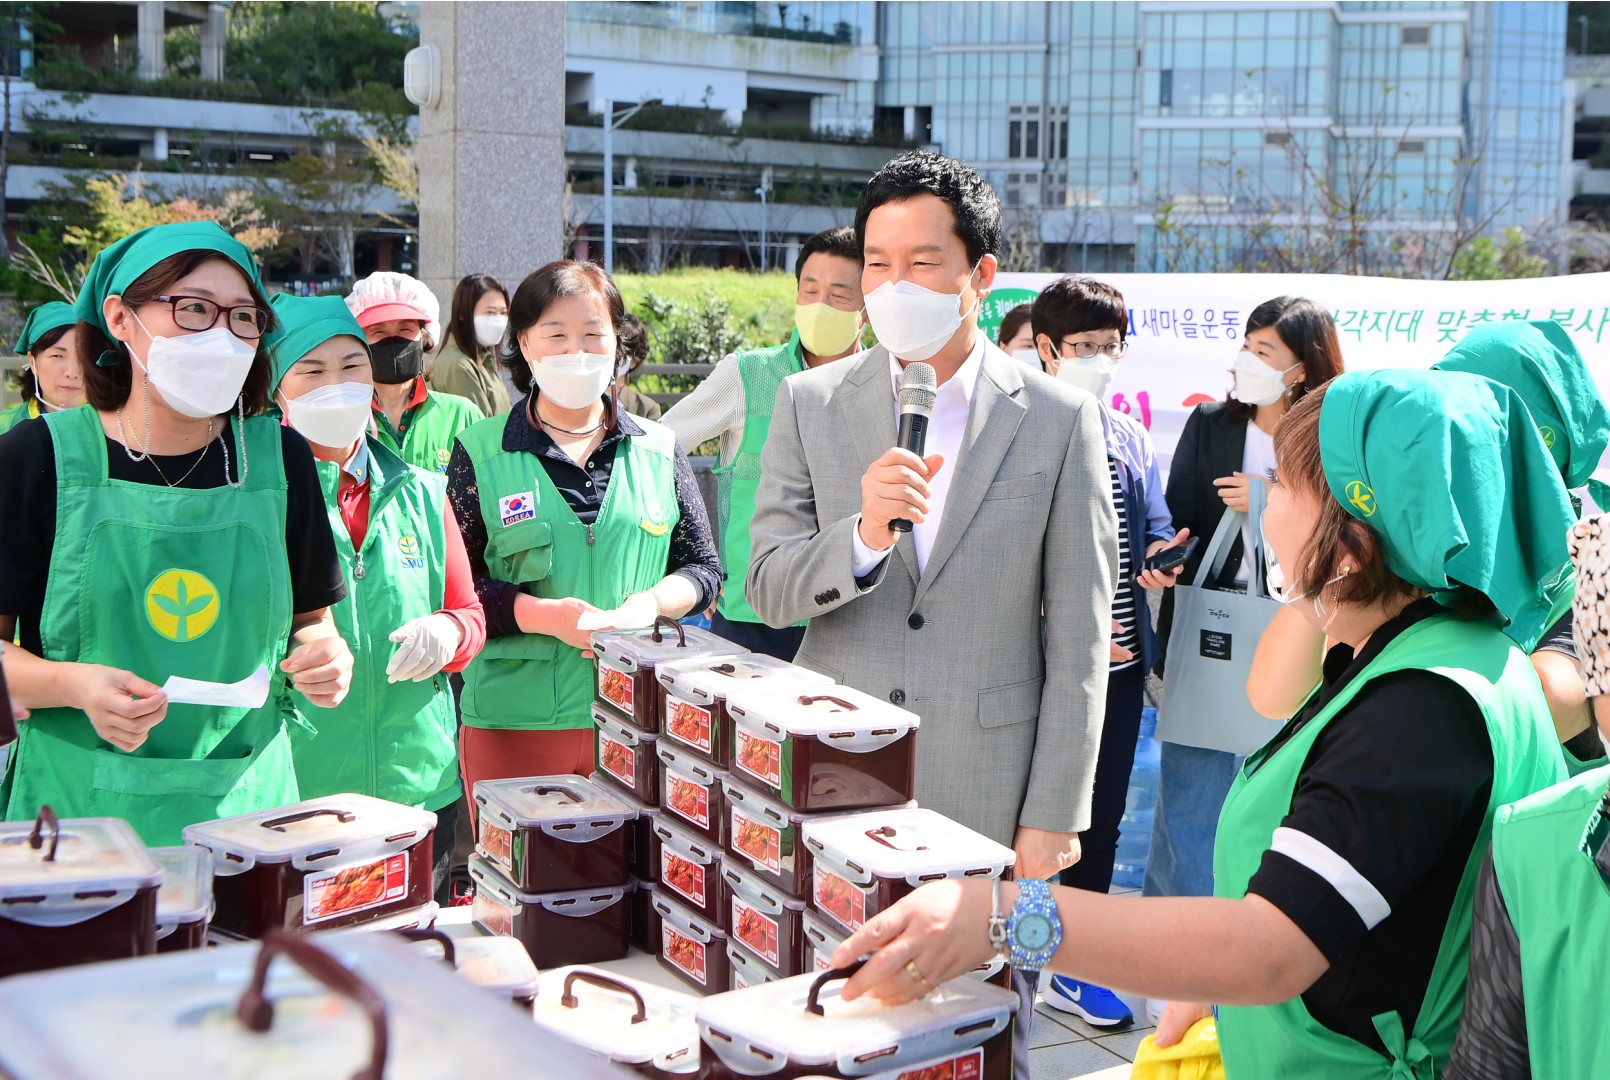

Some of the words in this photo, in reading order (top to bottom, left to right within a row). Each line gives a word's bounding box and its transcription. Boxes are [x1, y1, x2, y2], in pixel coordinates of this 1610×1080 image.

[1142, 308, 1240, 339] 새마을운동
[504, 511, 531, 525] KOREA
[401, 557, 424, 568] SMU
